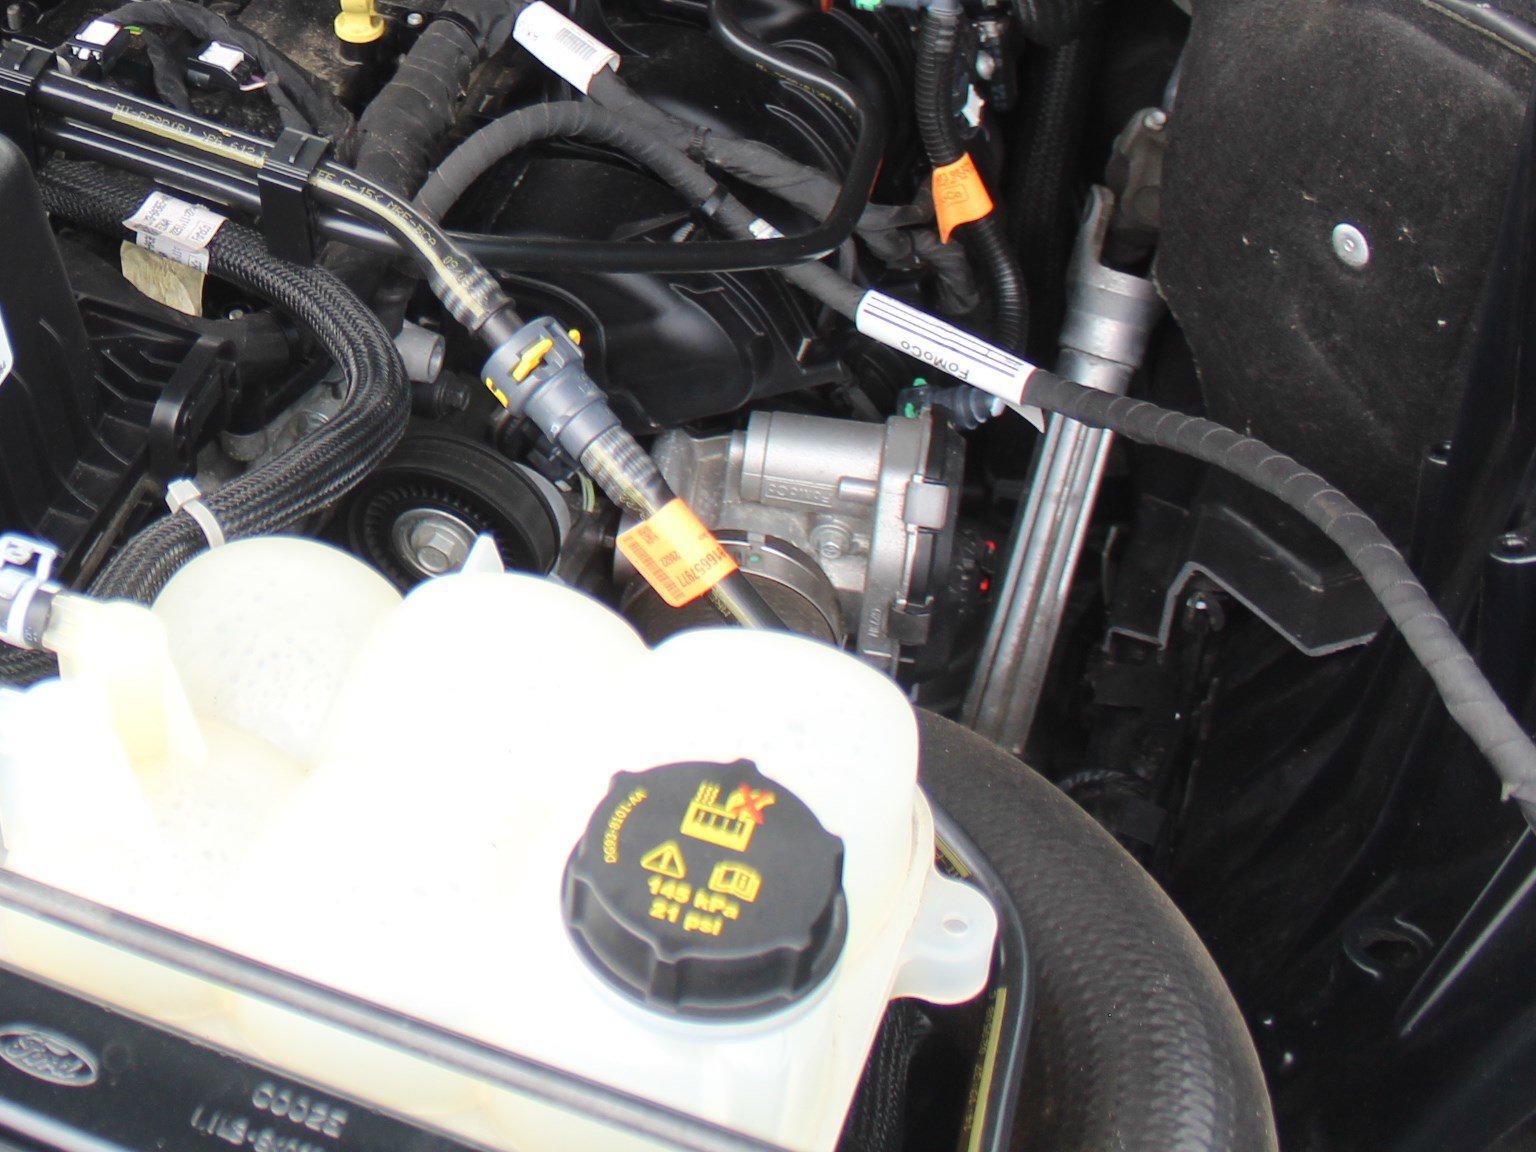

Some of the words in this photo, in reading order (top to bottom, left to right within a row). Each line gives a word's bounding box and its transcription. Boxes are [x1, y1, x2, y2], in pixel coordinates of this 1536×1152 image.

[901, 340, 969, 380] FoMoCo
[646, 876, 691, 904] 145
[692, 890, 740, 921] kPa
[648, 899, 680, 923] 21
[682, 910, 724, 937] psi
